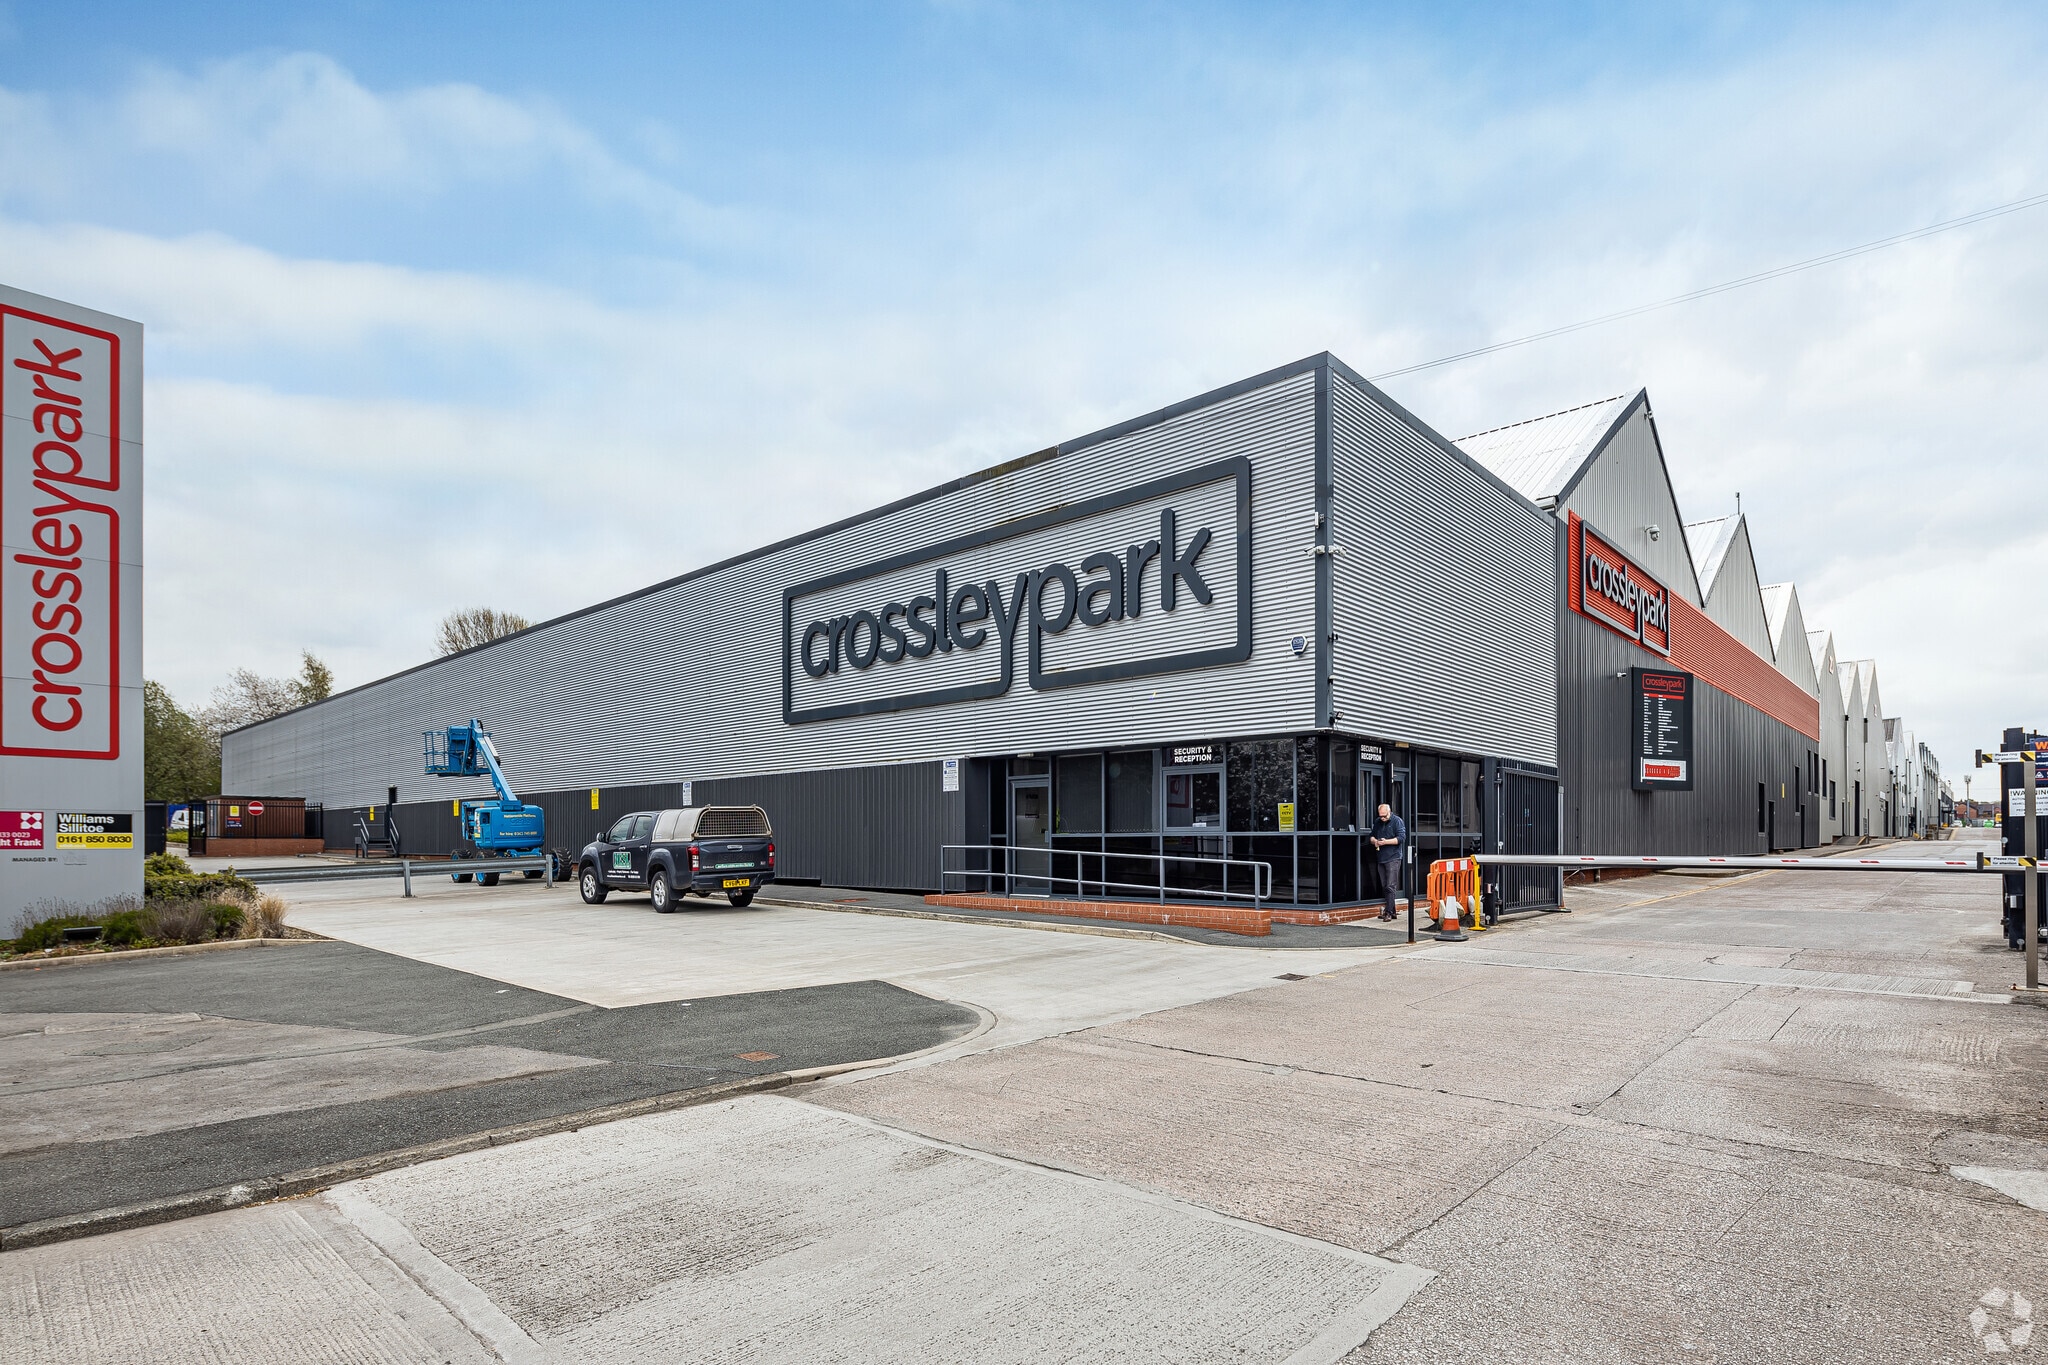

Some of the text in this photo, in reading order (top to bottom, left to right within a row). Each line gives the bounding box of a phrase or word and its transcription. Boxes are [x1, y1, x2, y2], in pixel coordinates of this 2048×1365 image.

[801, 507, 1214, 686] crossleypark
[1588, 553, 1667, 634] crossleypark
[1174, 747, 1206, 755] SECURITY
[1360, 744, 1378, 753] SECURITY
[1174, 754, 1212, 763] RECEPTION
[1360, 752, 1382, 762] RECEPTION
[58, 814, 115, 824] Williams
[58, 823, 105, 833] Sillitoe
[14, 838, 42, 846] Frank
